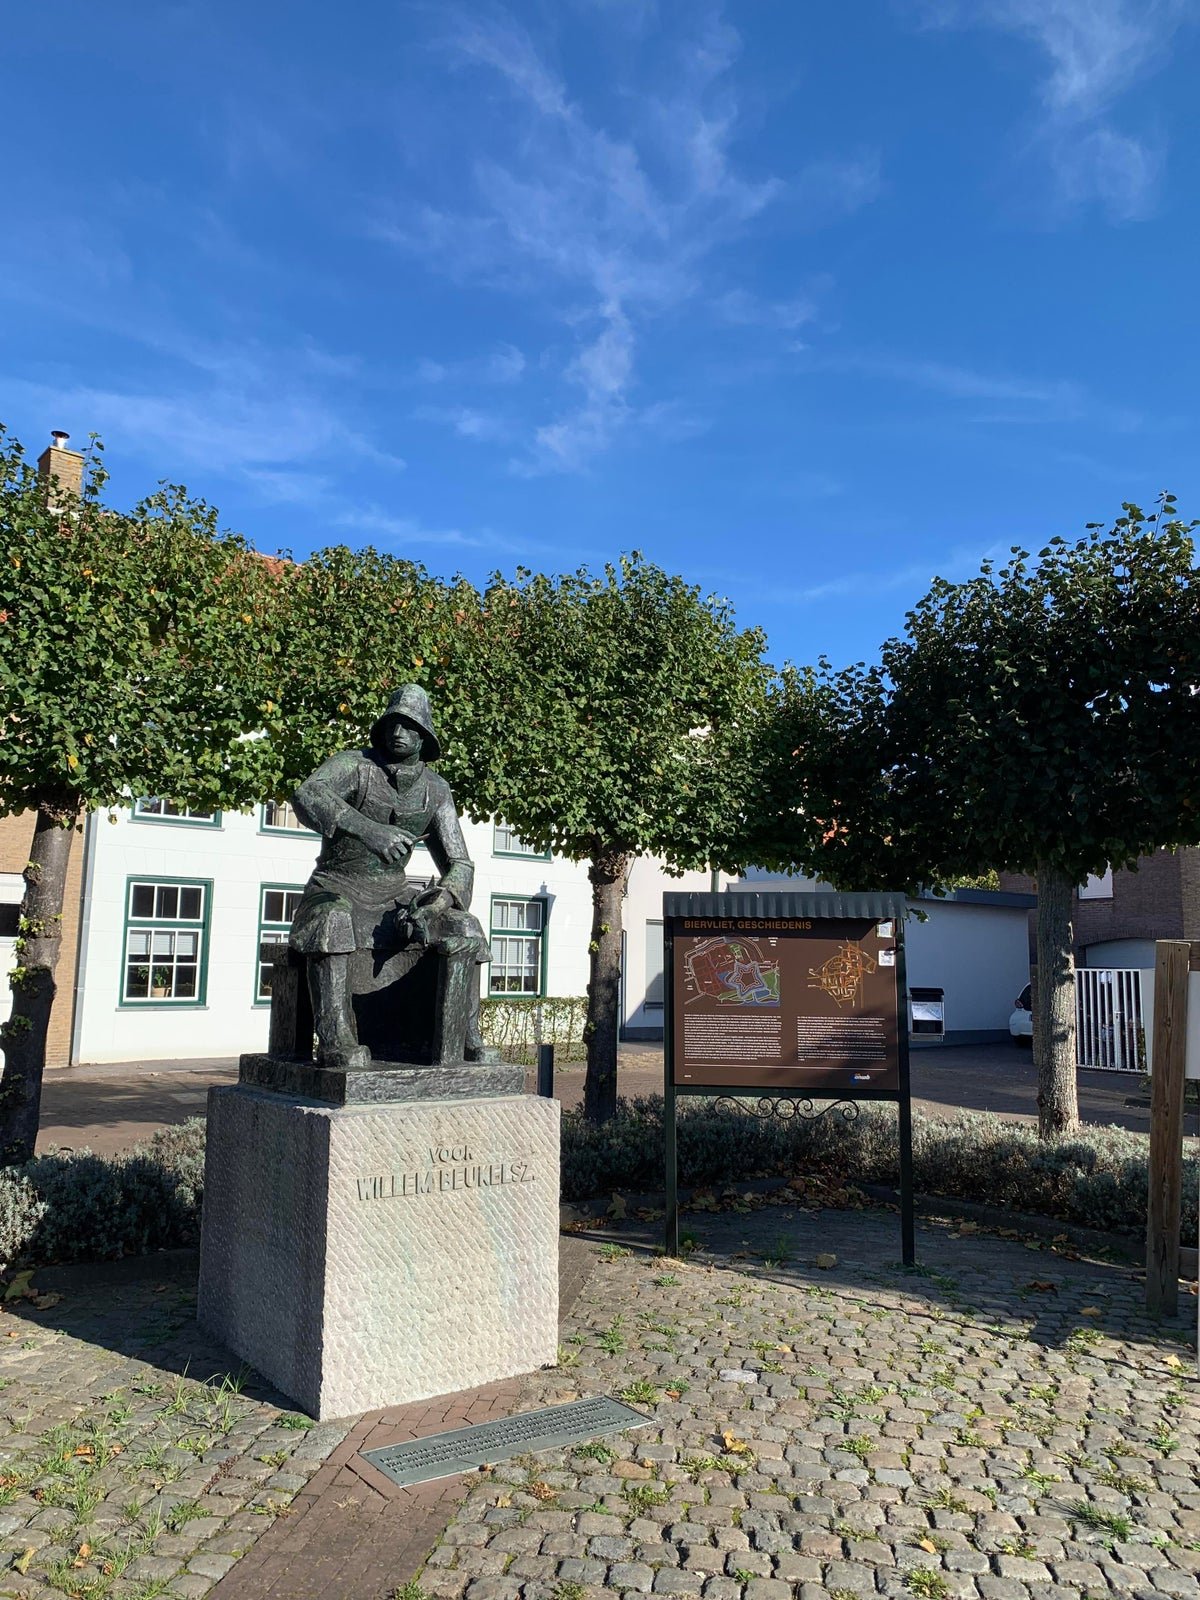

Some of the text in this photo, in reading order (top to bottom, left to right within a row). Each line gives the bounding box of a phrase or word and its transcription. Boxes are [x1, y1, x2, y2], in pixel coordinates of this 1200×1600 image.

[684, 920, 812, 930] BIERVLIET, GESCHIEDENIS
[429, 1145, 473, 1163] VOOR
[357, 1171, 433, 1201] WILLEM
